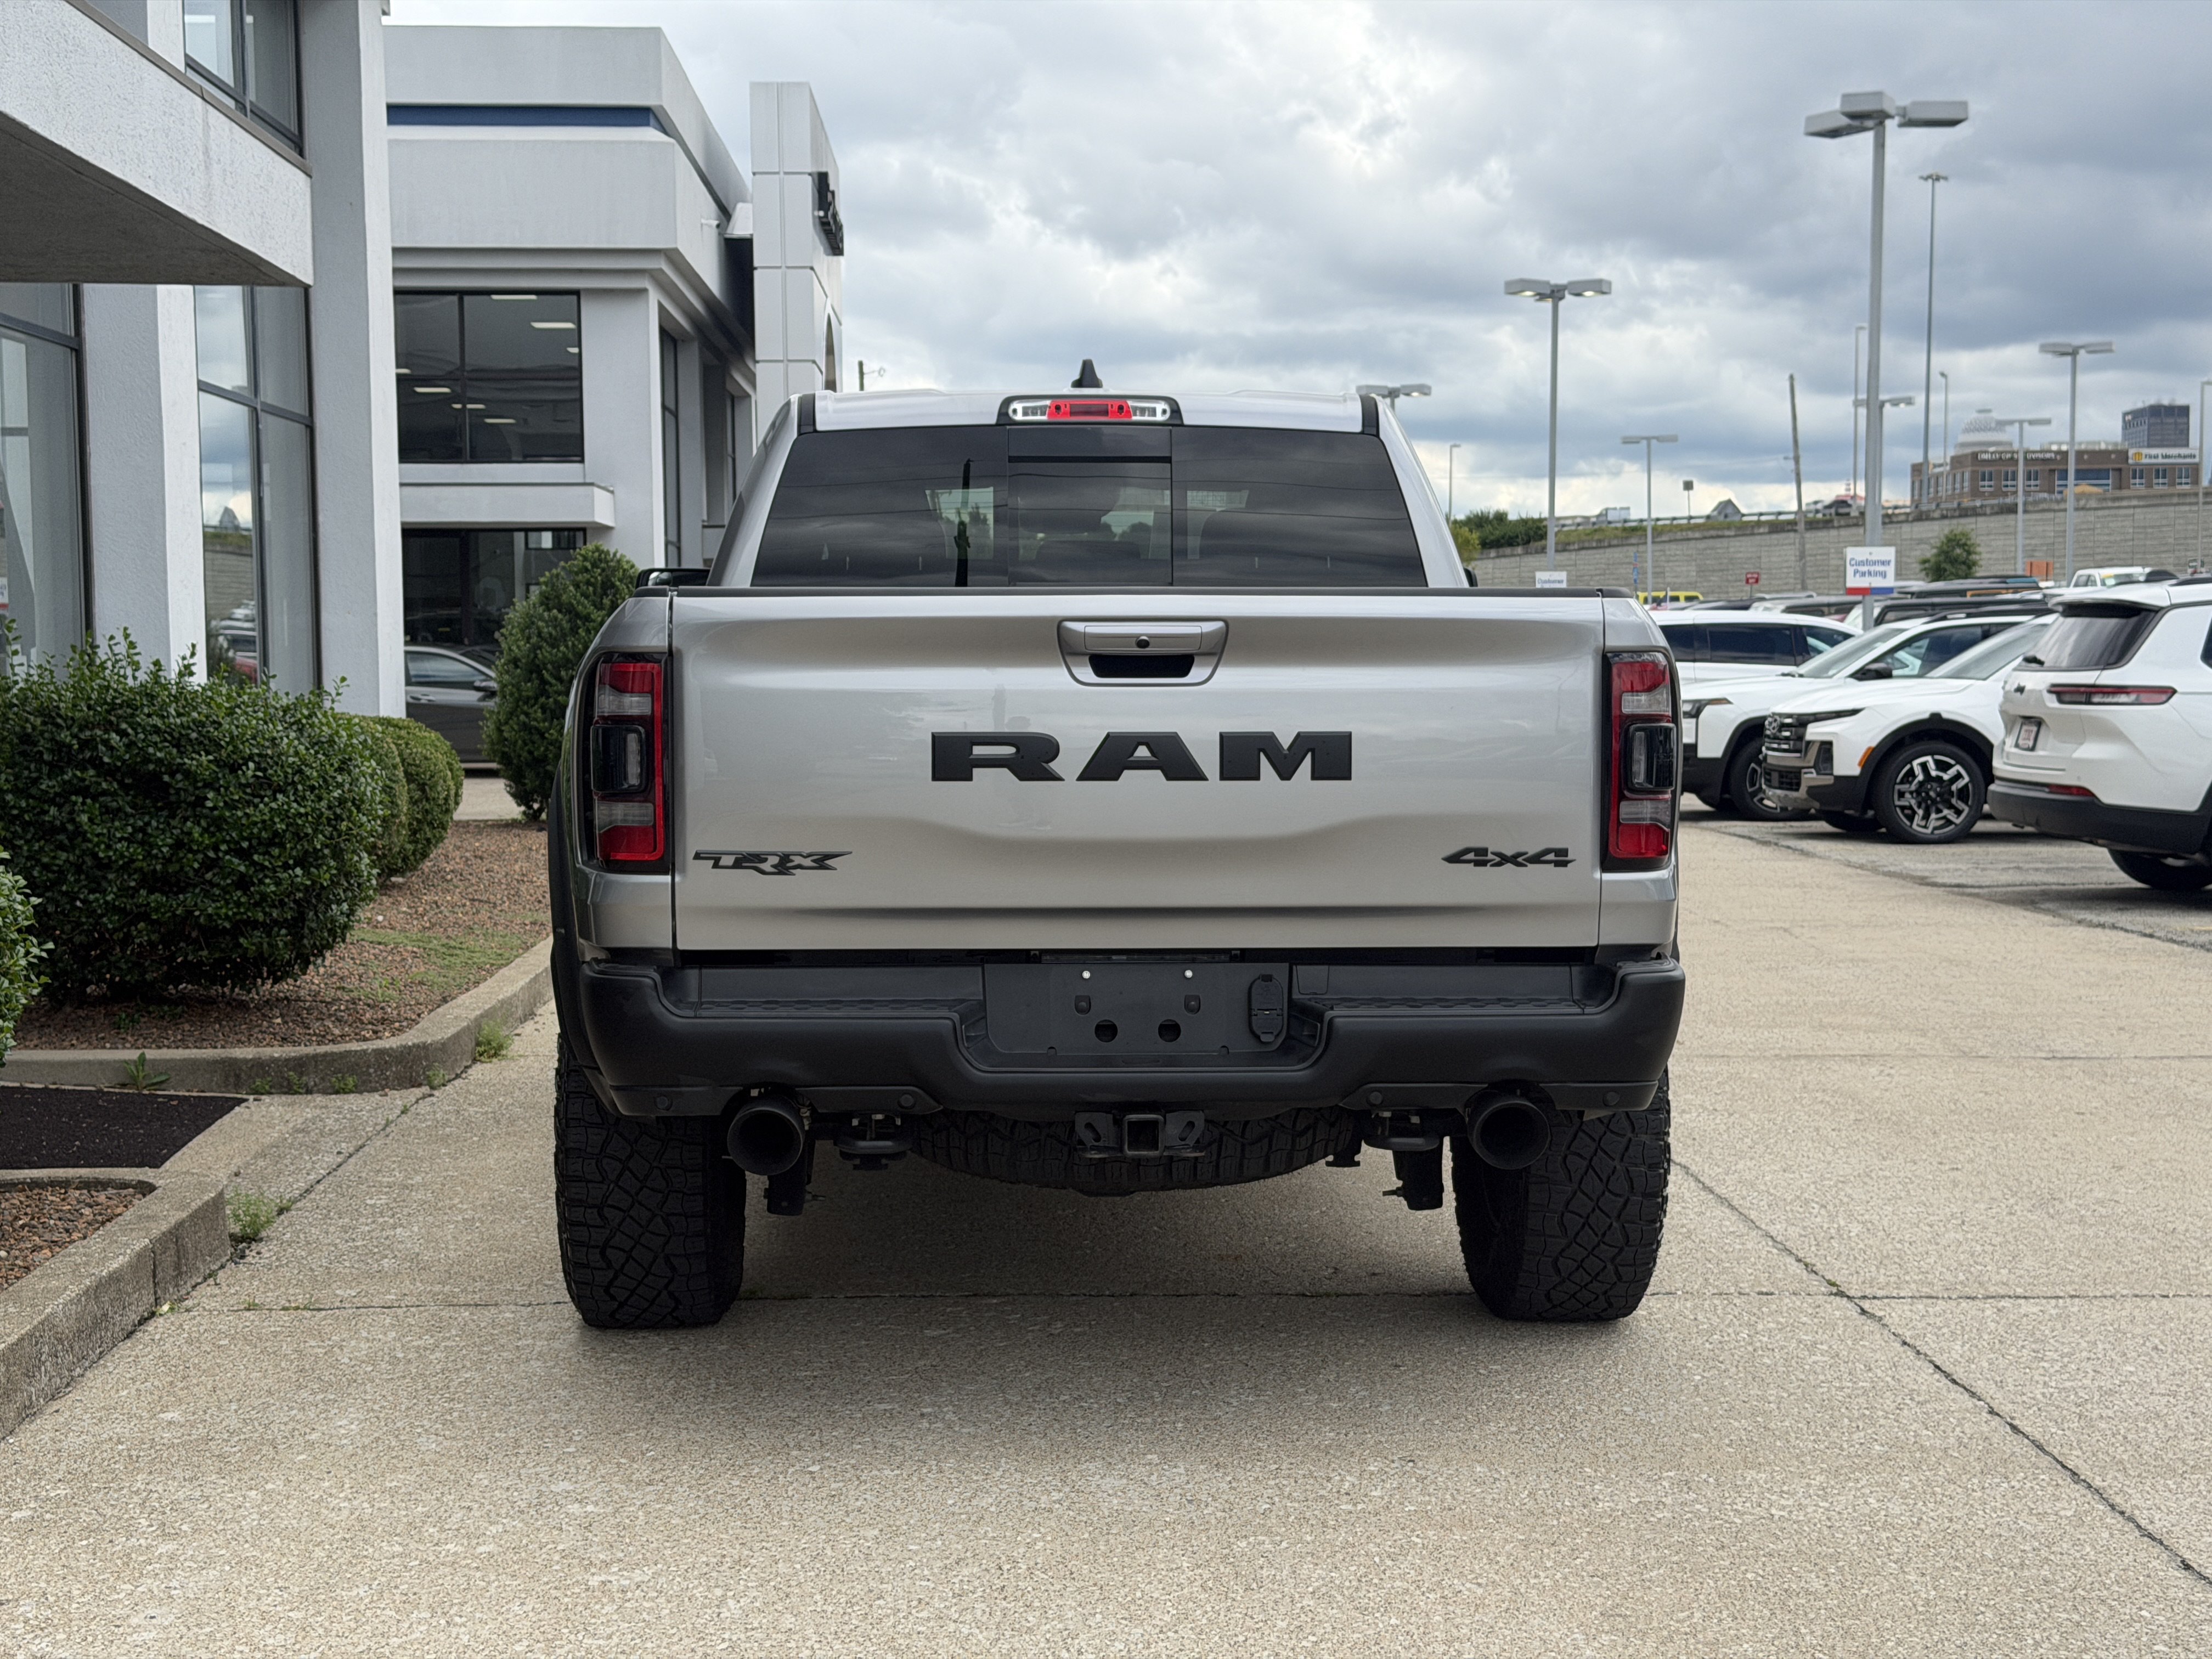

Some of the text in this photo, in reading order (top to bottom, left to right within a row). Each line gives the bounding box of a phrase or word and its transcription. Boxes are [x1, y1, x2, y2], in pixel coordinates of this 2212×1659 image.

[1849, 557, 1891, 567] Customer
[1853, 568, 1887, 579] Parking
[931, 732, 1352, 781] RAM
[692, 850, 853, 876] TRX
[1441, 847, 1577, 867] 4x4
